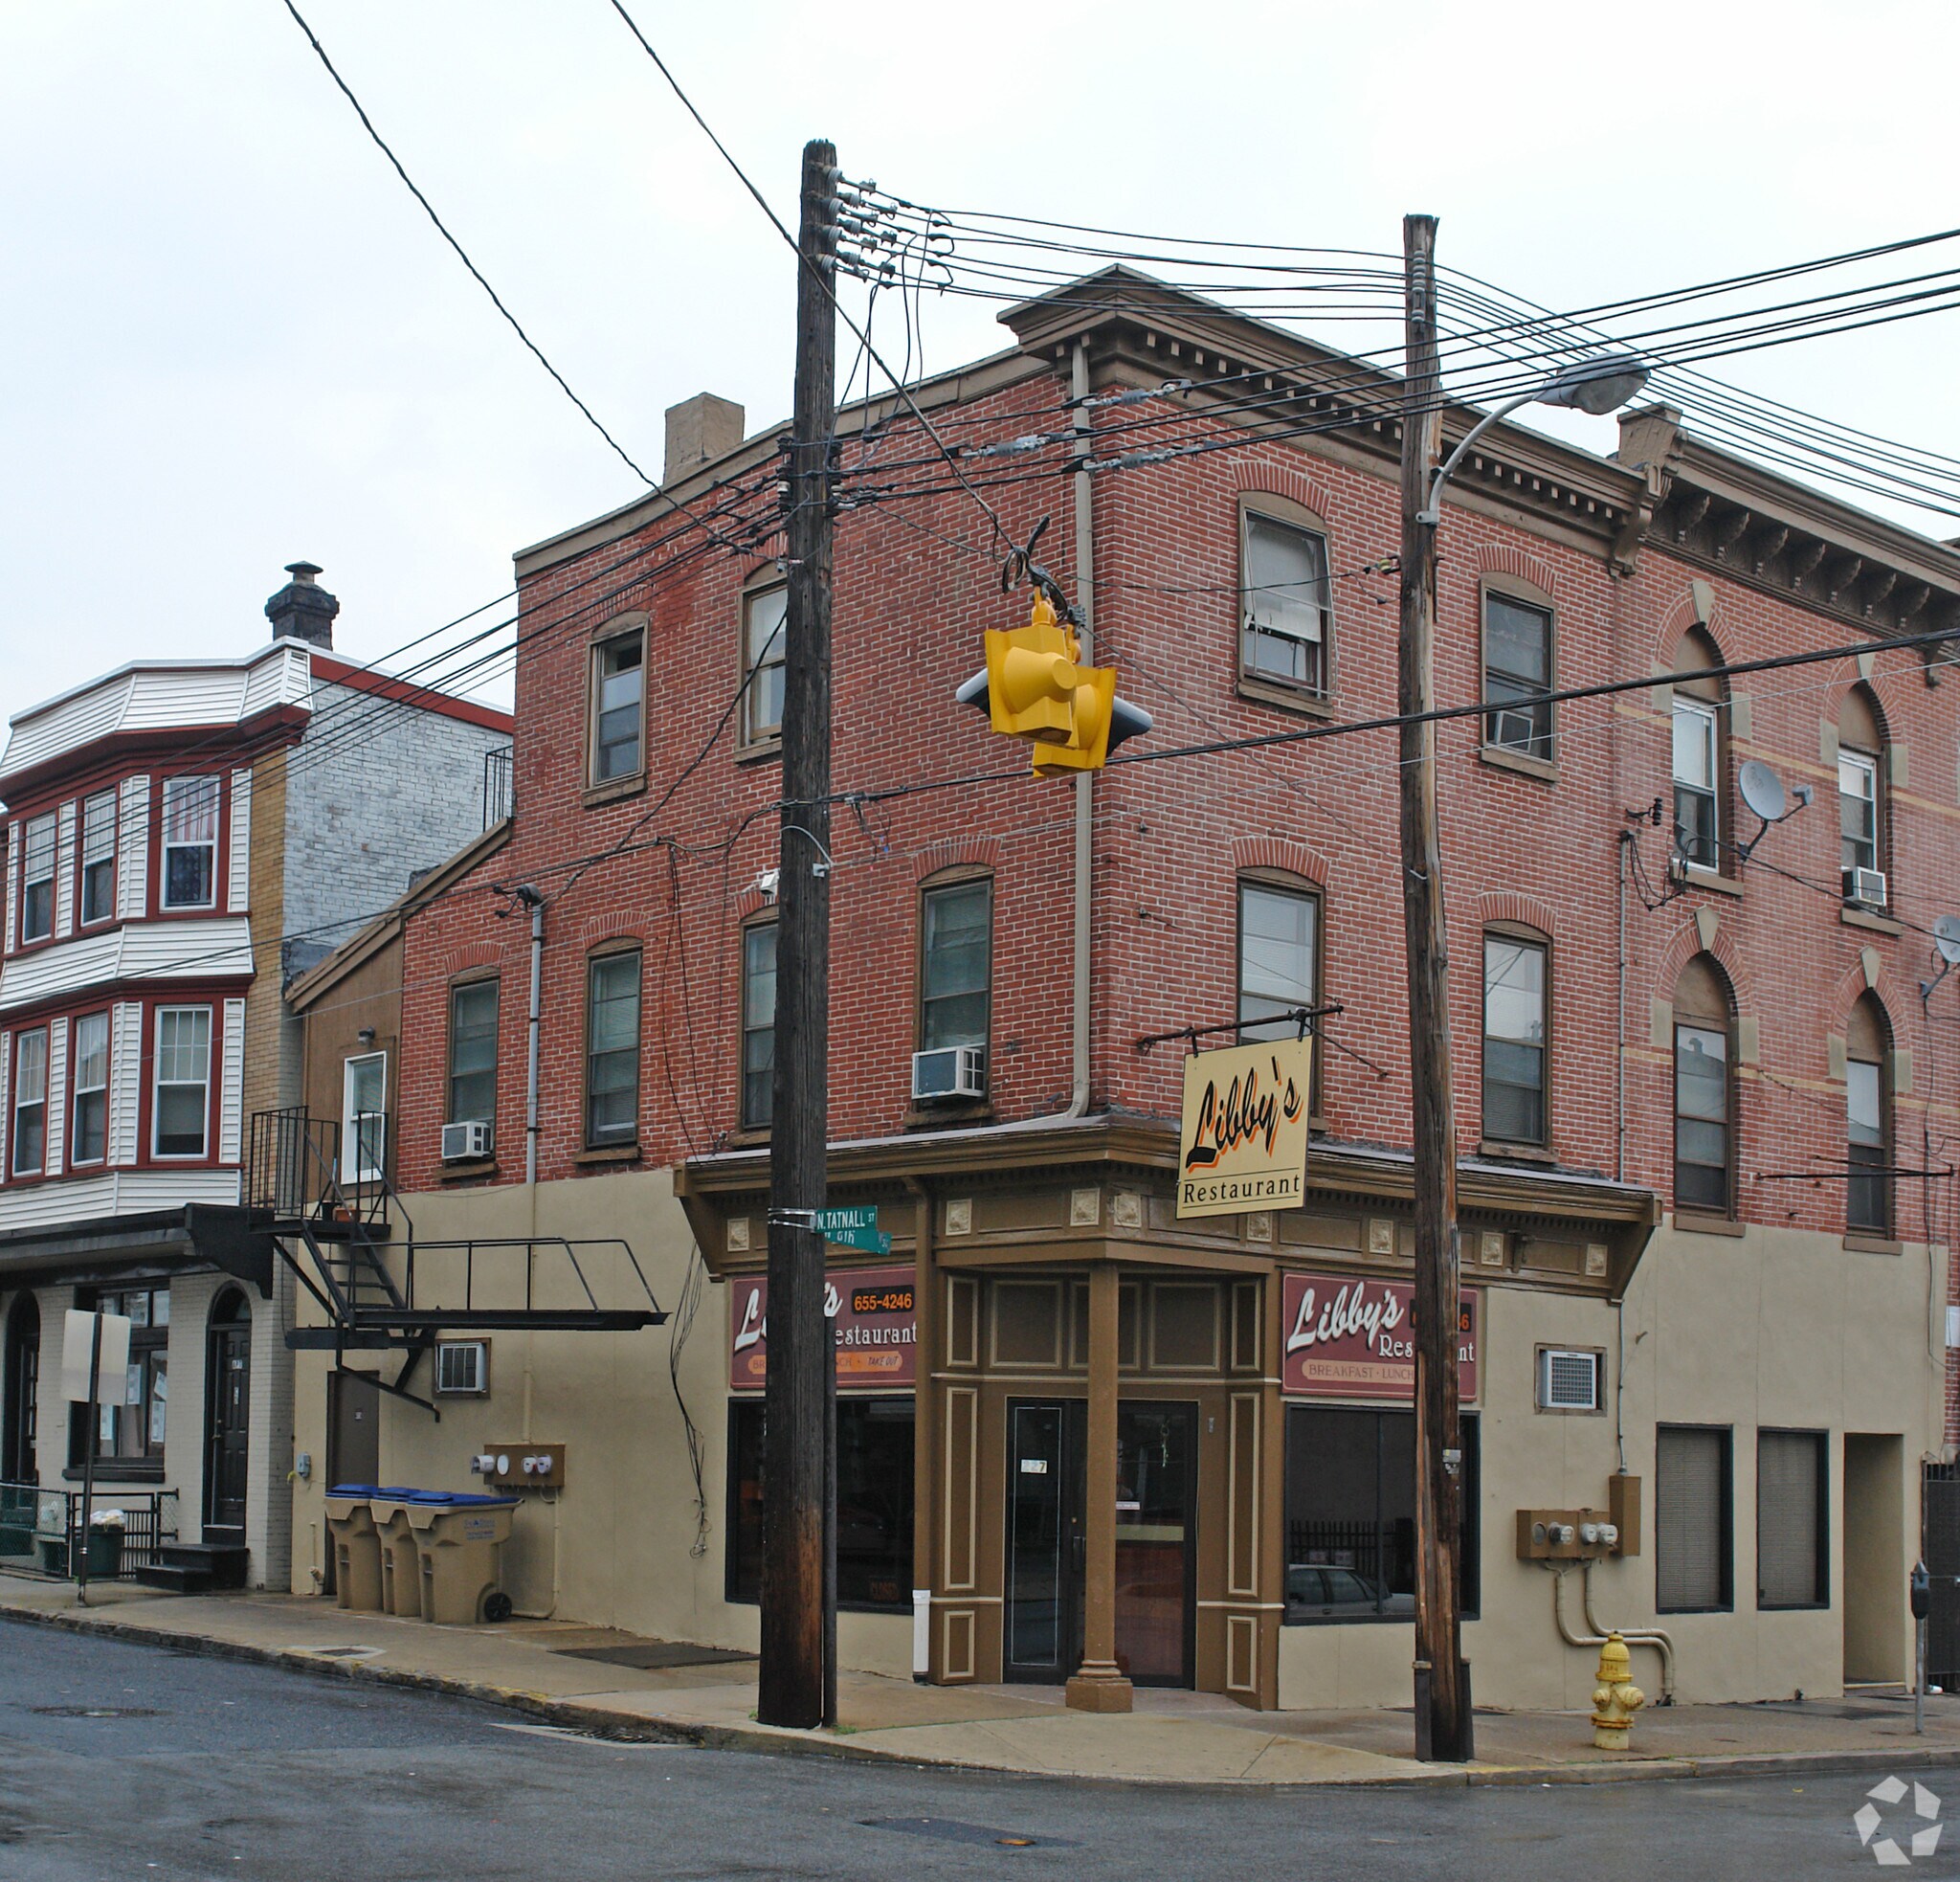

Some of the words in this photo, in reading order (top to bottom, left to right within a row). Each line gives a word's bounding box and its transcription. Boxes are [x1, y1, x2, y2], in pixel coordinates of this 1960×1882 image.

[1185, 1056, 1303, 1174] Libby's
[1184, 1175, 1301, 1203] Restaurant
[826, 1210, 866, 1229] TATNALL
[855, 1292, 913, 1311] 655-4246
[1287, 1281, 1405, 1354] Libby's
[835, 1321, 917, 1345] estaurant
[1378, 1334, 1475, 1362] Resnt
[868, 1355, 884, 1366] TAKE
[885, 1355, 899, 1366] OUT
[1308, 1363, 1374, 1378] BREAKFAST
[1381, 1368, 1414, 1381] LUNCH
